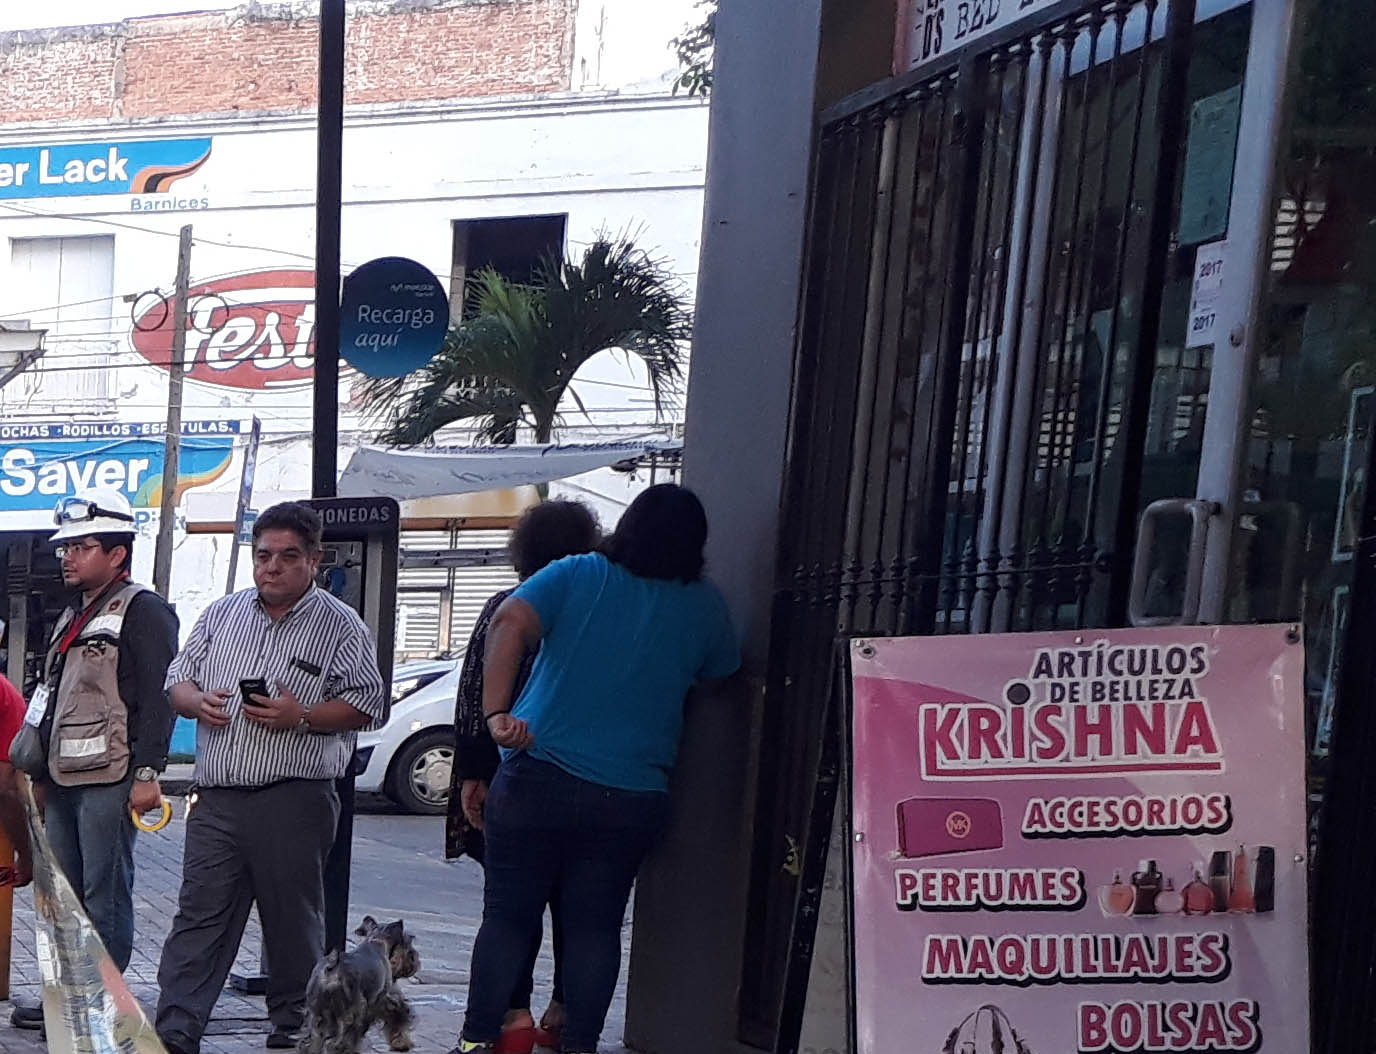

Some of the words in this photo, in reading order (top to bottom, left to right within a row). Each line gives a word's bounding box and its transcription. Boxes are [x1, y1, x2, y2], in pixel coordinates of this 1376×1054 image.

[39, 147, 130, 184] Lack
[129, 196, 210, 212] Barnices
[1199, 260, 1224, 278] 2017
[358, 304, 435, 327] Recarga
[1192, 313, 1216, 331] 2017
[354, 329, 402, 351] aquí
[63, 423, 131, 436] RODILLOS
[141, 421, 233, 434] ESPTULAS.
[0, 447, 149, 498] Sayer
[1032, 641, 1206, 680] ARTÍCULOS
[1050, 681, 1080, 704] DE
[1091, 678, 1196, 702] BELLEZA
[1025, 795, 1226, 830] ACCESORIOS
[898, 870, 1078, 903] PERFUMES
[926, 934, 1222, 977] MAQUILLAJES
[1080, 1002, 1254, 1049] BOLSAS
